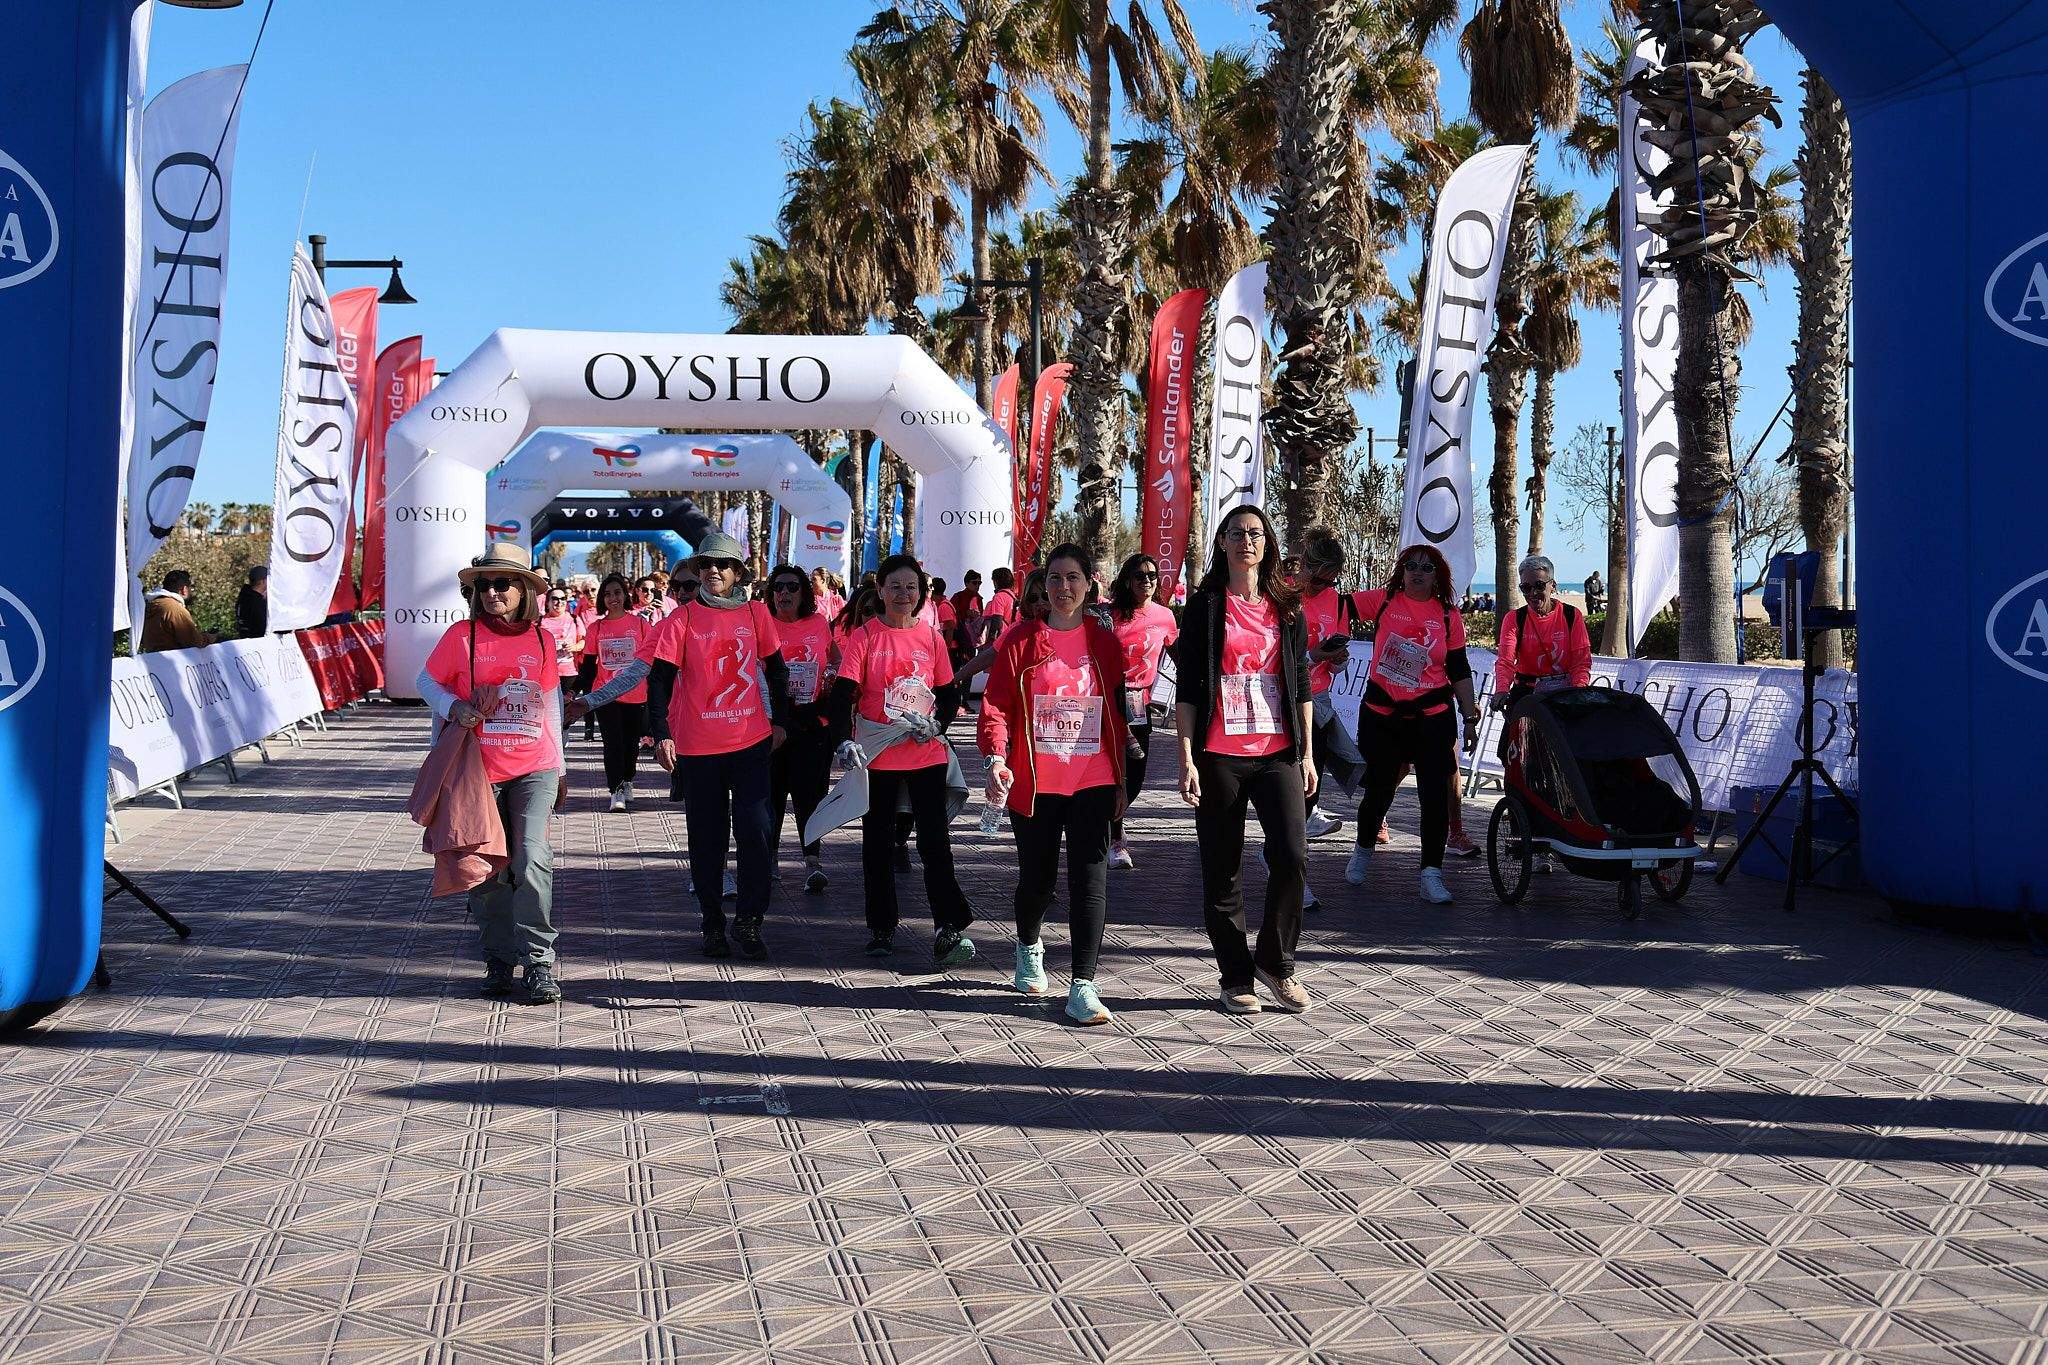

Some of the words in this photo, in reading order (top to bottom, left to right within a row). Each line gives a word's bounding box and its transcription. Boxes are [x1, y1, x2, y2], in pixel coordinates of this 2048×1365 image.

[145, 151, 223, 540] OYSHO
[584, 352, 831, 403] OYSHO
[1416, 209, 1495, 544] OYSHO
[1158, 326, 1186, 466] Santander
[430, 406, 508, 424] OYSHO
[900, 410, 971, 426] OYSHO
[1219, 314, 1256, 511] YSHO
[284, 294, 347, 563] OYSHO
[1031, 390, 1053, 495] Santander
[593, 470, 642, 478] TotalEnergies
[691, 470, 740, 478] TotalEnergies
[395, 506, 467, 523] OYSHO
[561, 508, 664, 518] VOLVO
[940, 510, 1005, 526] OYSHO
[806, 544, 844, 552] TotalEnergi
[394, 608, 465, 624] OYSHO
[1395, 656, 1413, 669] 016
[111, 672, 174, 730] OYSHO
[506, 703, 528, 714] 016
[1588, 675, 1732, 743] SHO
[1056, 720, 1082, 731] 016
